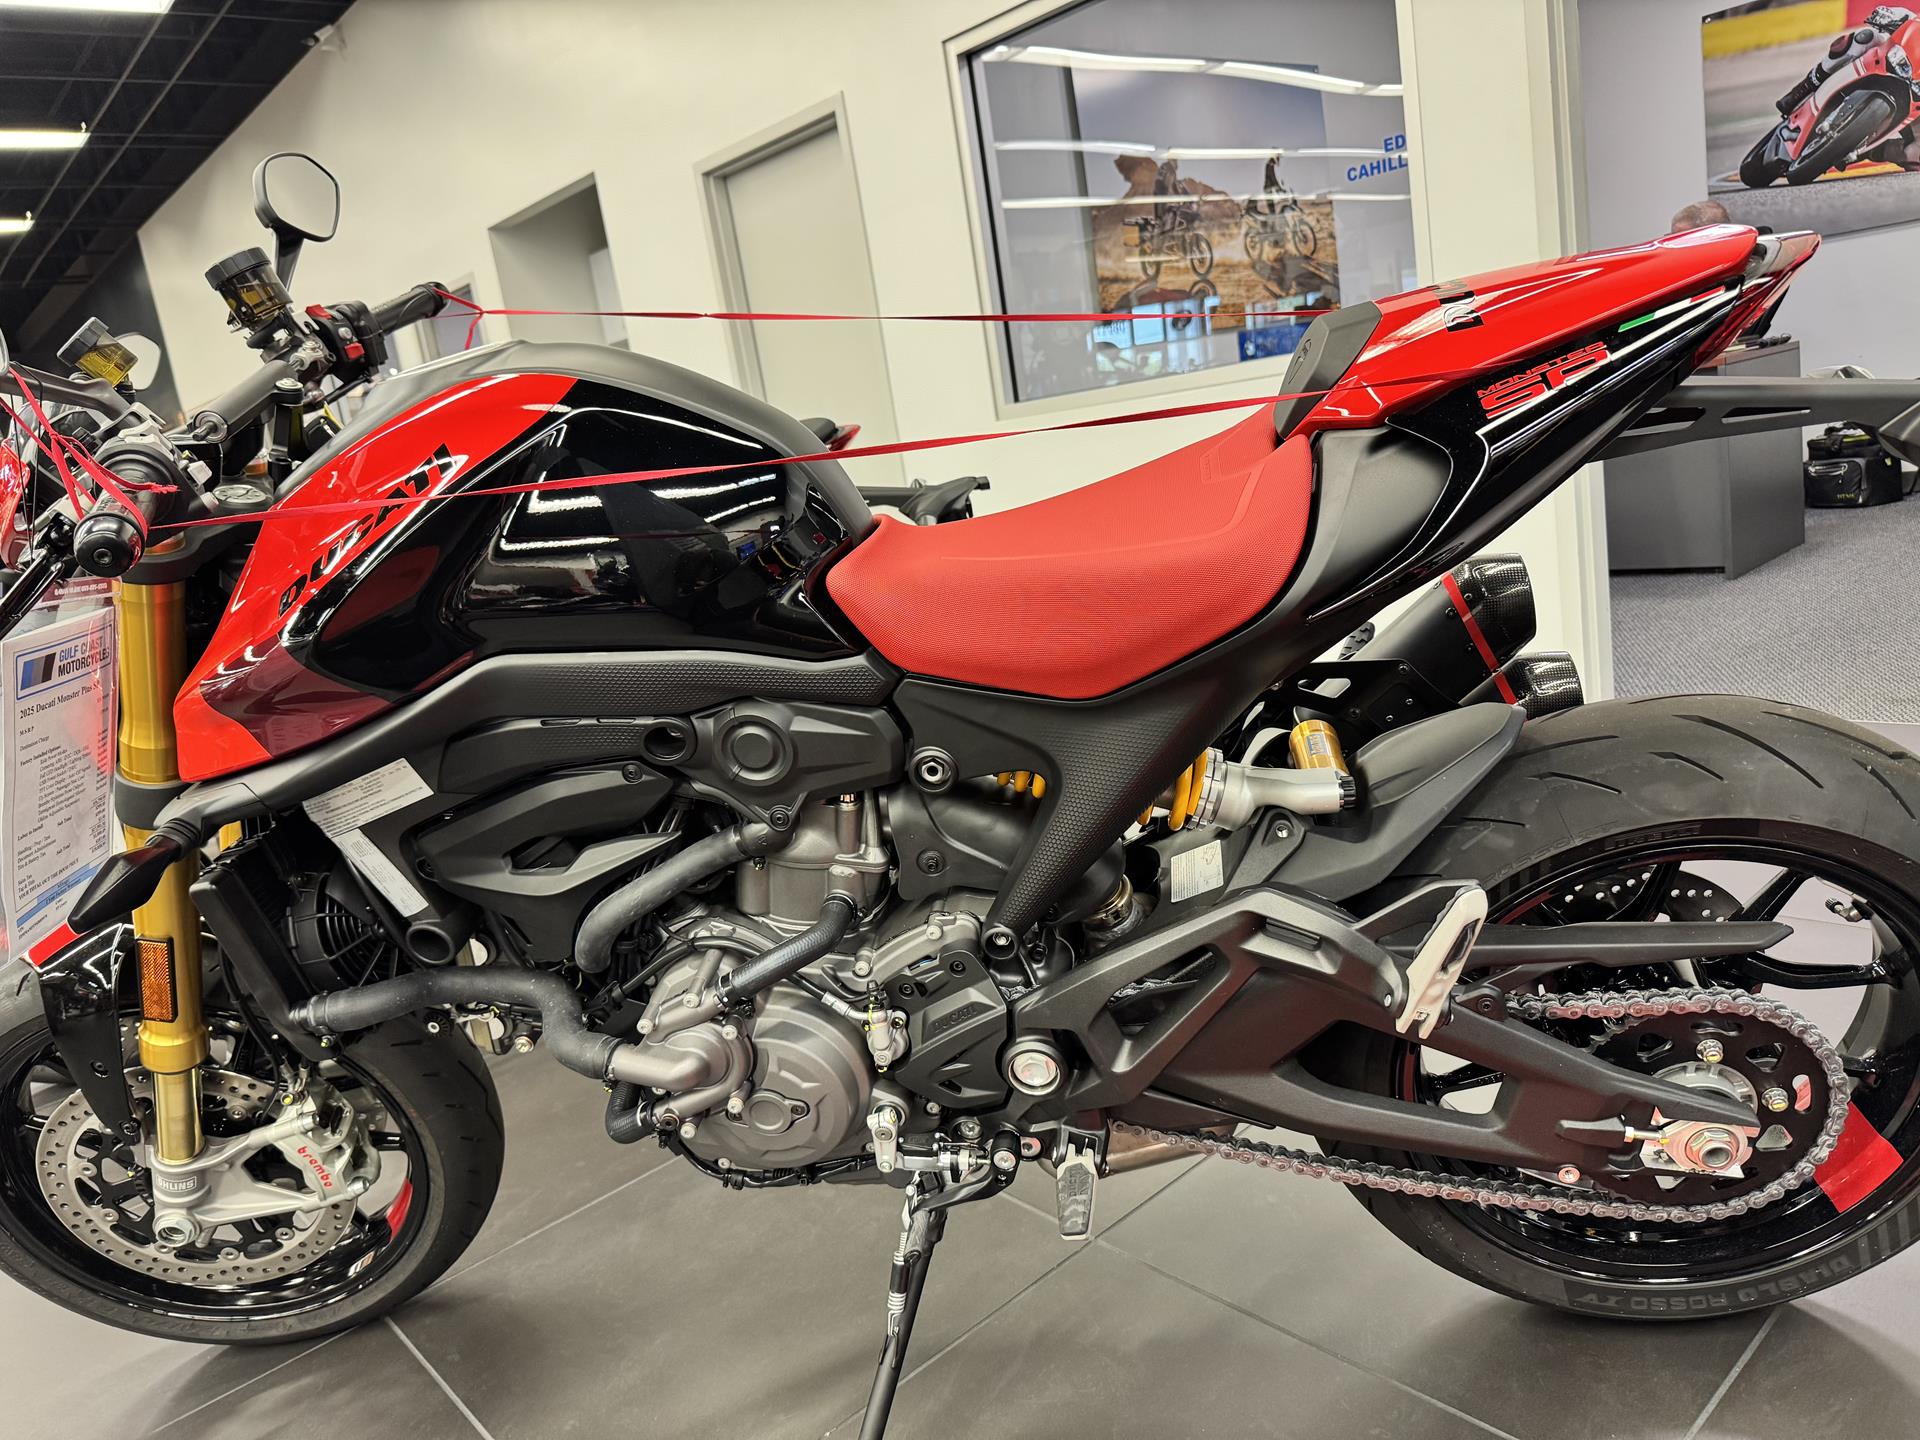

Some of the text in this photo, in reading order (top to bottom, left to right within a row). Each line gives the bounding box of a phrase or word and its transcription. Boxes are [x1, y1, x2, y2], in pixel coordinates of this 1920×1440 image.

[1384, 134, 1406, 152] ED
[1347, 154, 1408, 181] CAHILL
[1477, 341, 1607, 398] MONSTER
[1480, 349, 1612, 419] SP
[278, 443, 456, 618] DUCATI
[58, 647, 110, 678] MOTORCYCLES
[59, 637, 103, 663] GULF COAST
[20, 705, 35, 719] 2025
[36, 697, 56, 713] Ducati
[56, 689, 80, 704] Monster
[297, 1145, 333, 1188] brembo
[1630, 1292, 1728, 1310] ROSSO
